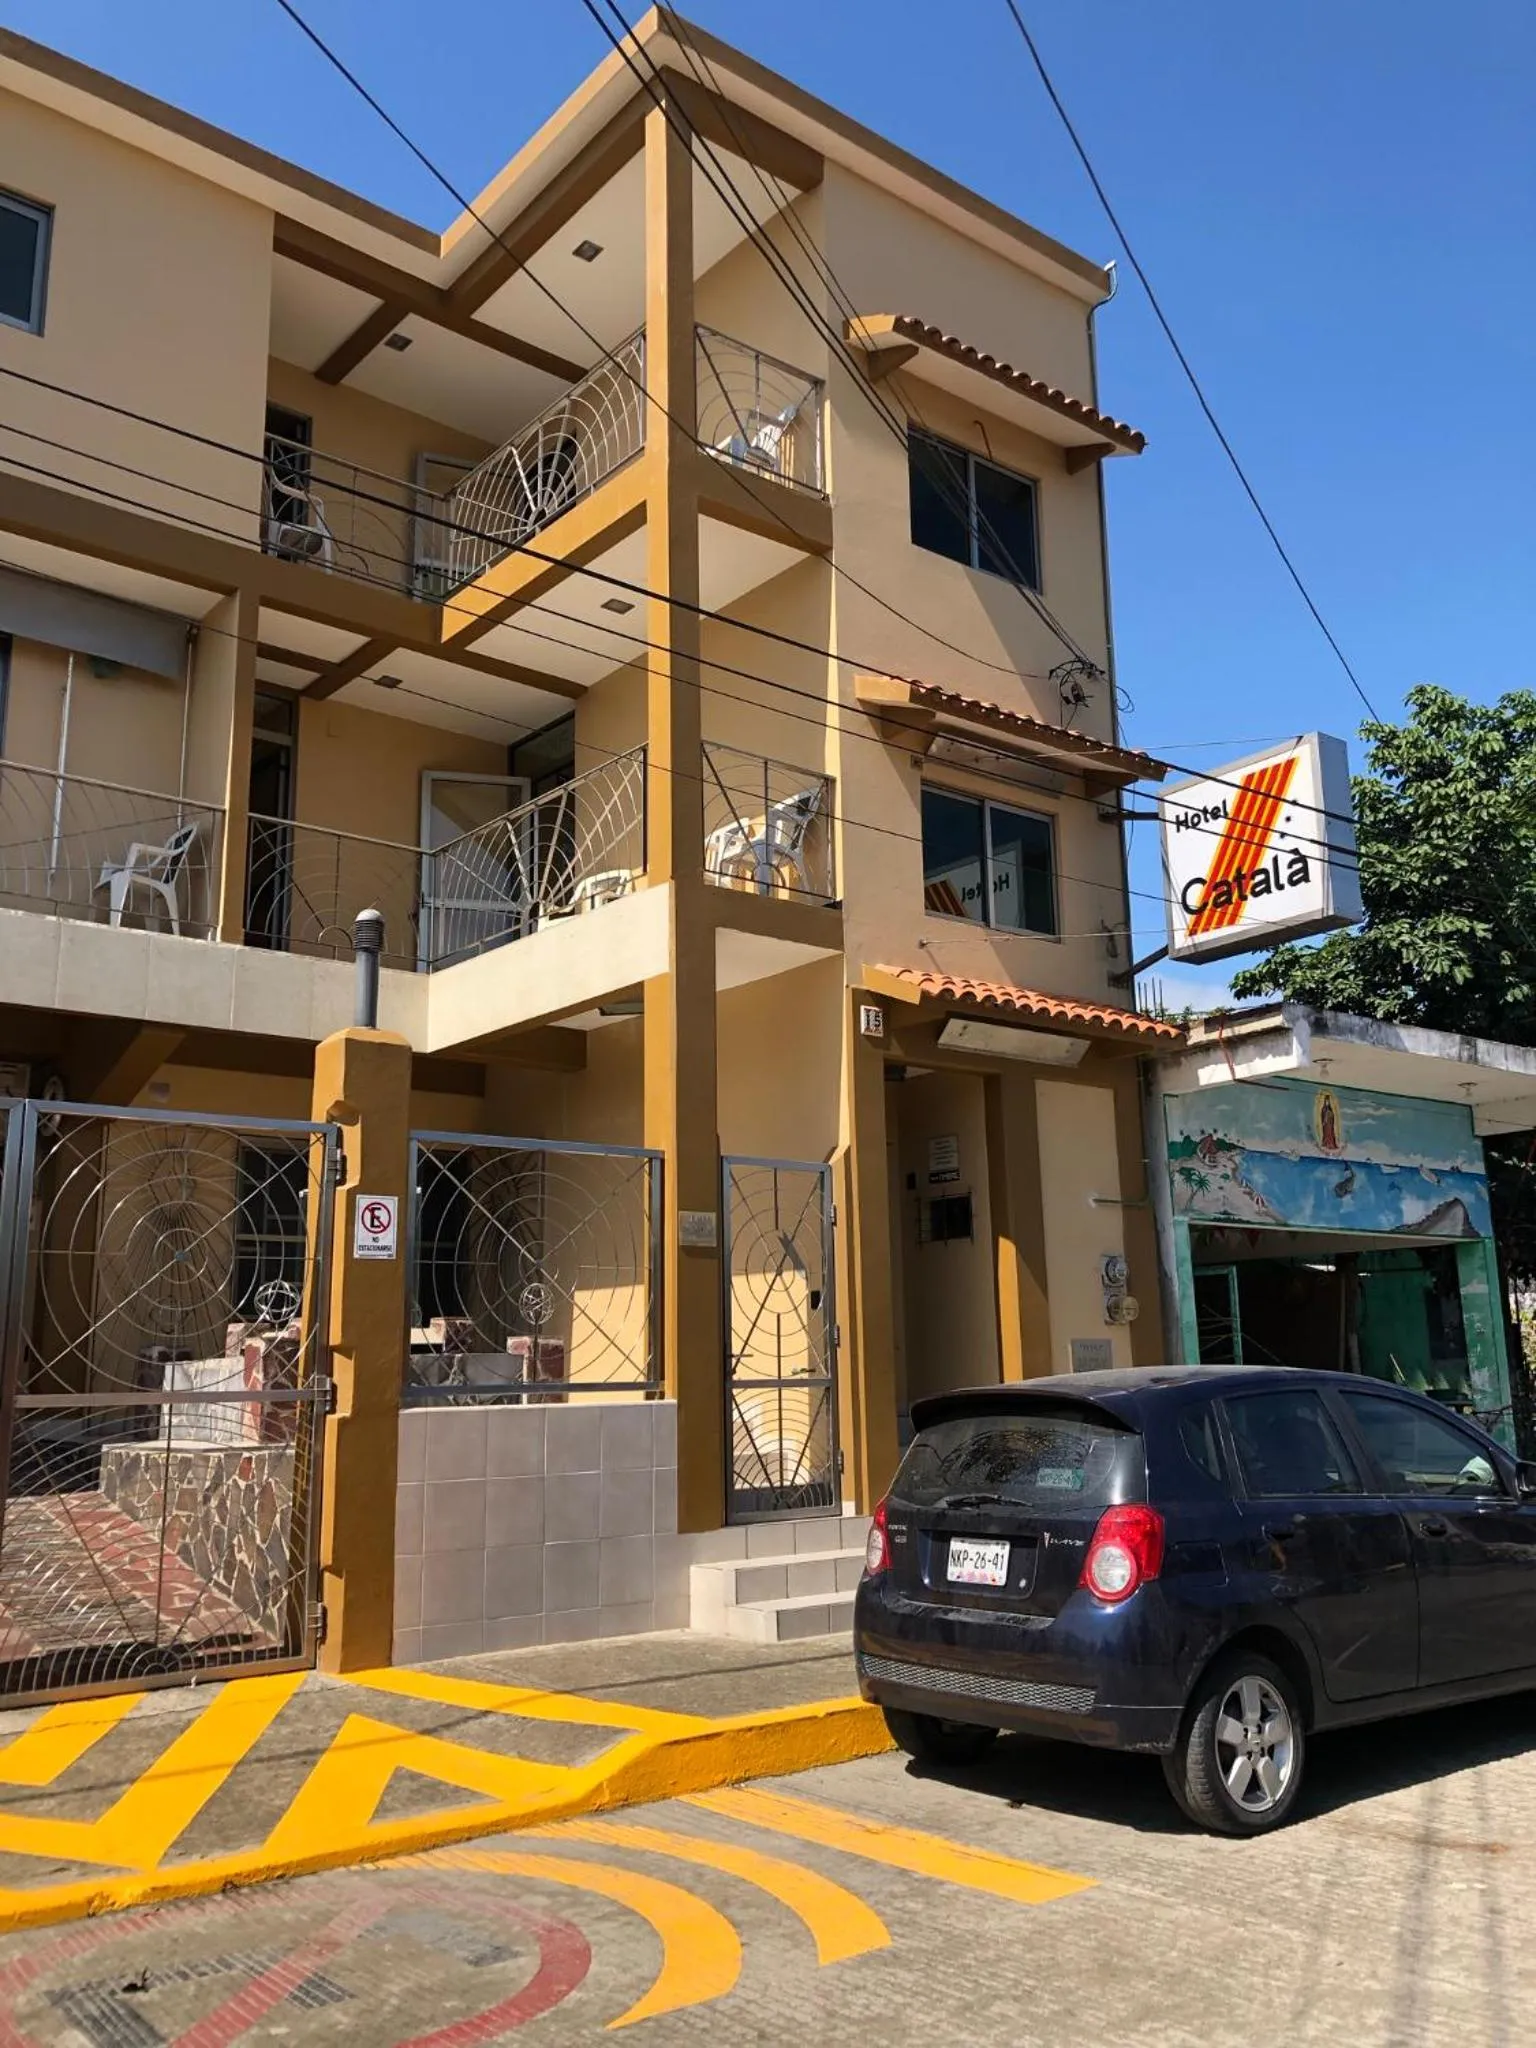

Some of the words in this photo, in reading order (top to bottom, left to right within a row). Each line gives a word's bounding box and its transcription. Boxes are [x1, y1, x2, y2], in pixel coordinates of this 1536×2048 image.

[1175, 799, 1229, 833] Hotel
[1181, 848, 1312, 916] Català
[949, 1548, 1005, 1571] NKP-26-41
